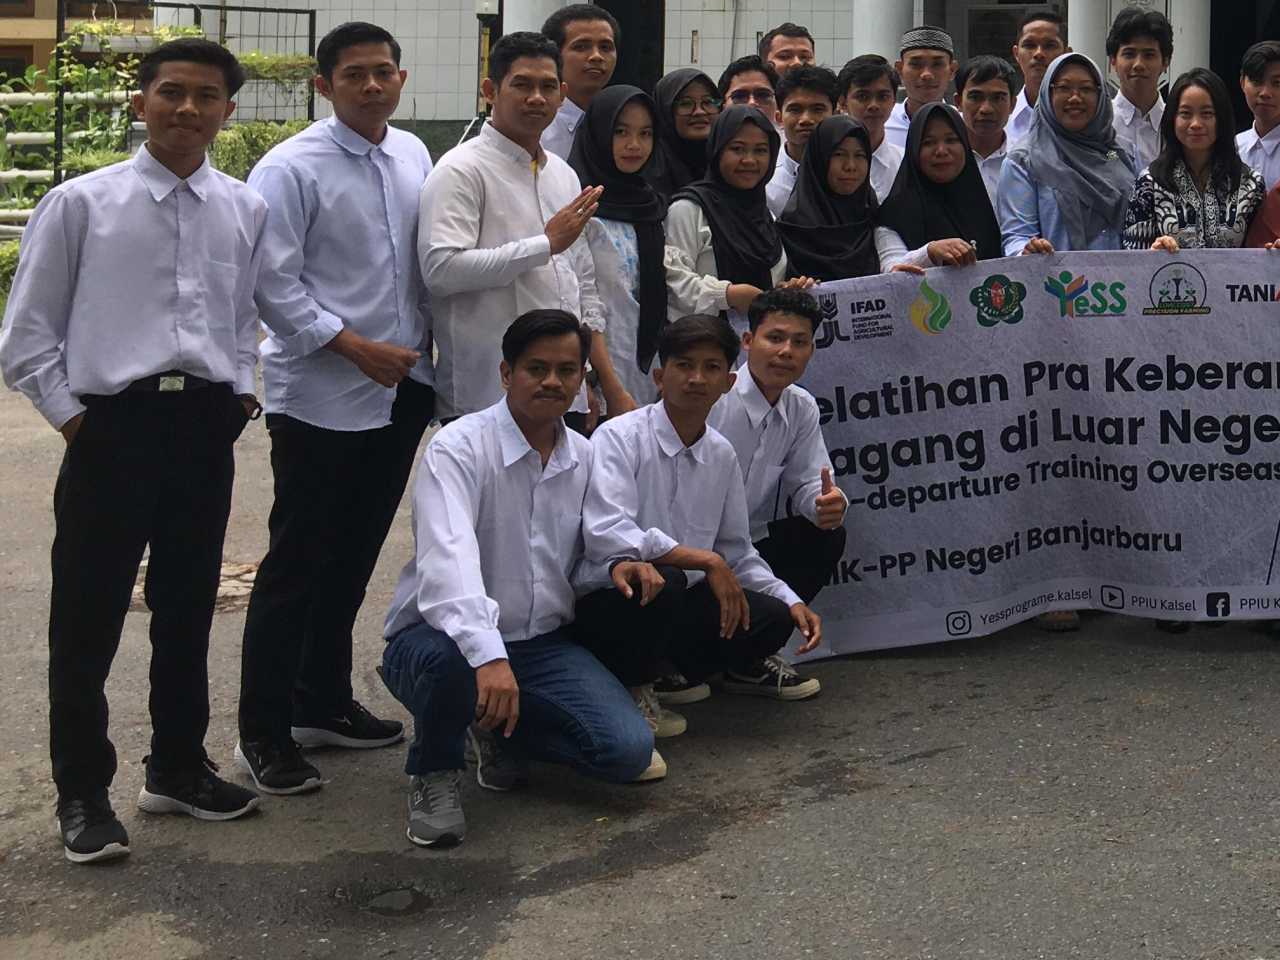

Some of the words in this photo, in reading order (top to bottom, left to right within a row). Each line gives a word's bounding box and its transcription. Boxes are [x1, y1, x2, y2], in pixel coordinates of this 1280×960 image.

[850, 299, 886, 314] IFAD
[815, 372, 1009, 426] elatihan
[1023, 360, 1090, 397] Pra
[828, 429, 986, 485] agang
[1000, 410, 1038, 454] di
[1051, 408, 1145, 446] Luar
[850, 471, 1020, 513] -departure
[1026, 453, 1139, 492] Training
[832, 551, 916, 586] K-PP
[926, 532, 1021, 575] Negeri
[1027, 519, 1183, 553] Banjarbaru
[980, 588, 1092, 625] Yessprograme.kalsel
[1131, 595, 1157, 609] PPIU
[1160, 598, 1196, 612] Kalsel
[1240, 598, 1270, 610] PPIU
